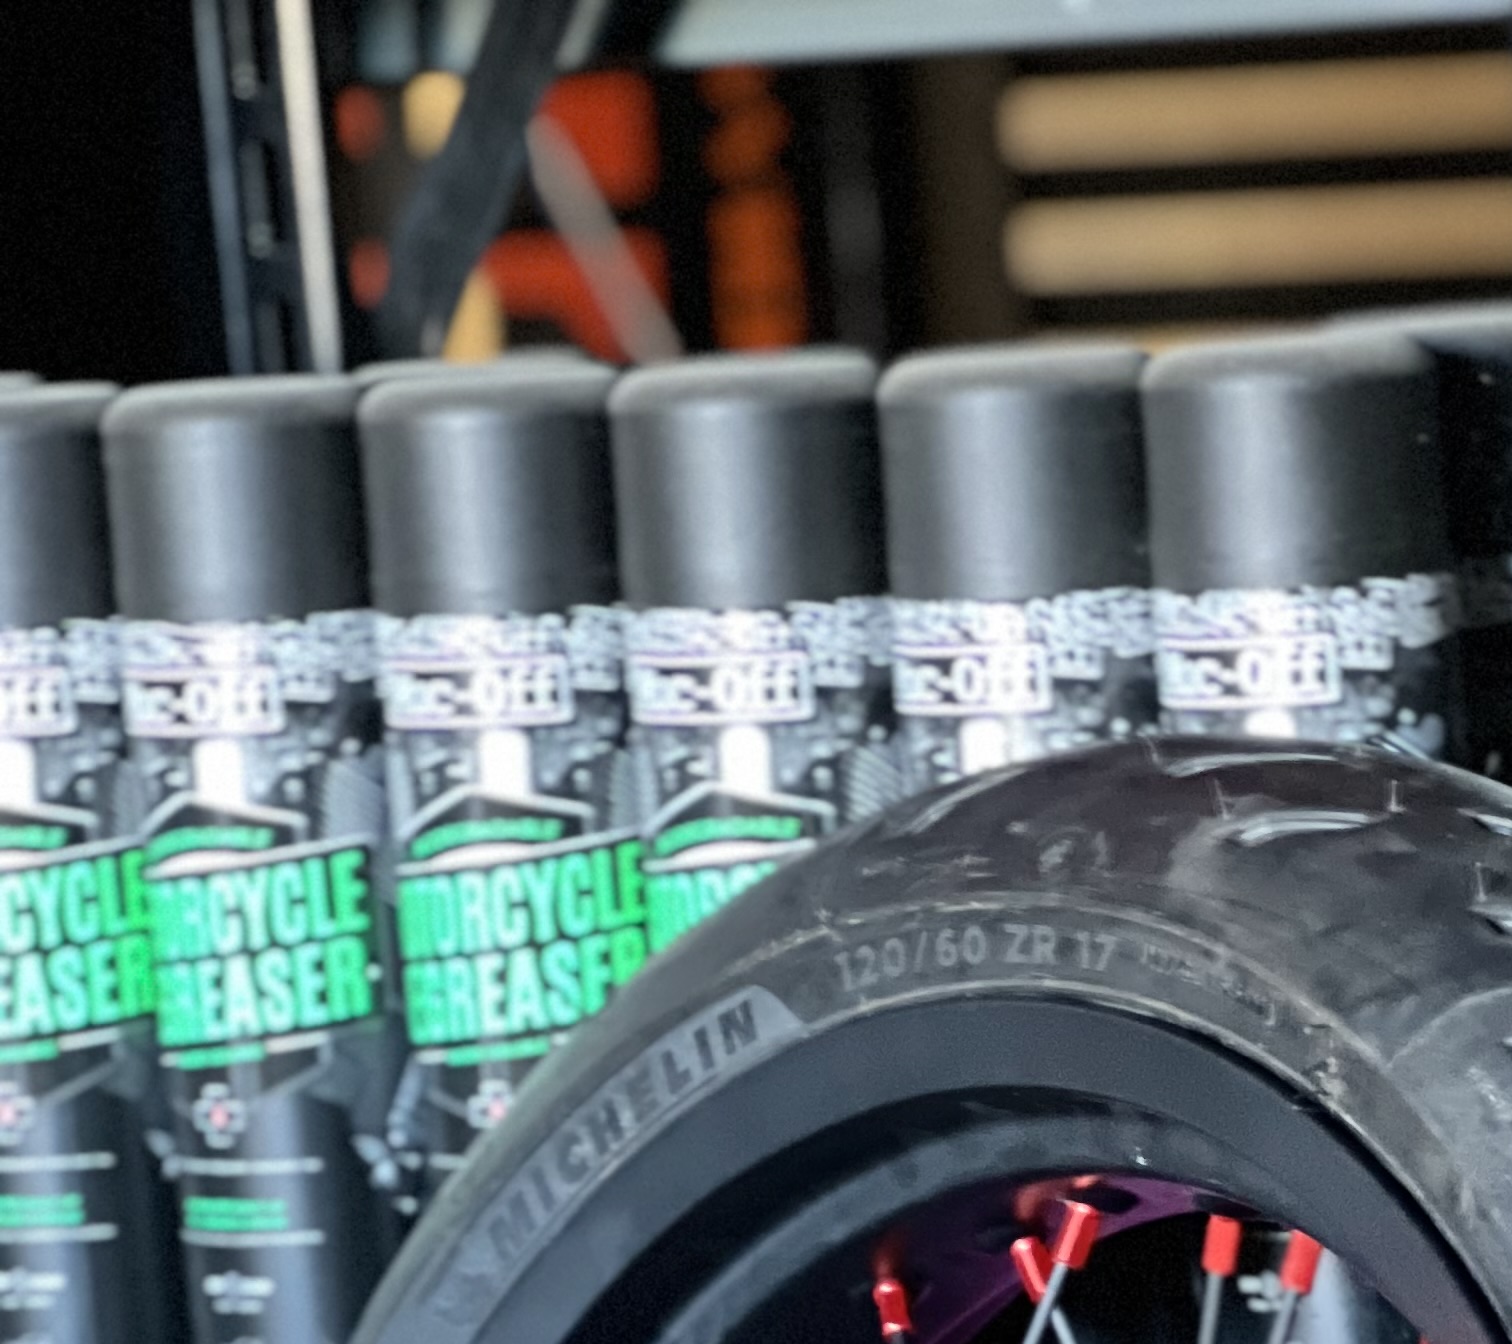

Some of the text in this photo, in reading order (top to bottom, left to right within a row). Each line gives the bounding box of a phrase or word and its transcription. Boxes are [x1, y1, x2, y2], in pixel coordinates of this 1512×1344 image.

[833, 923, 1118, 991] 120/60 ZR 17
[486, 998, 760, 1266] MICHELIN
